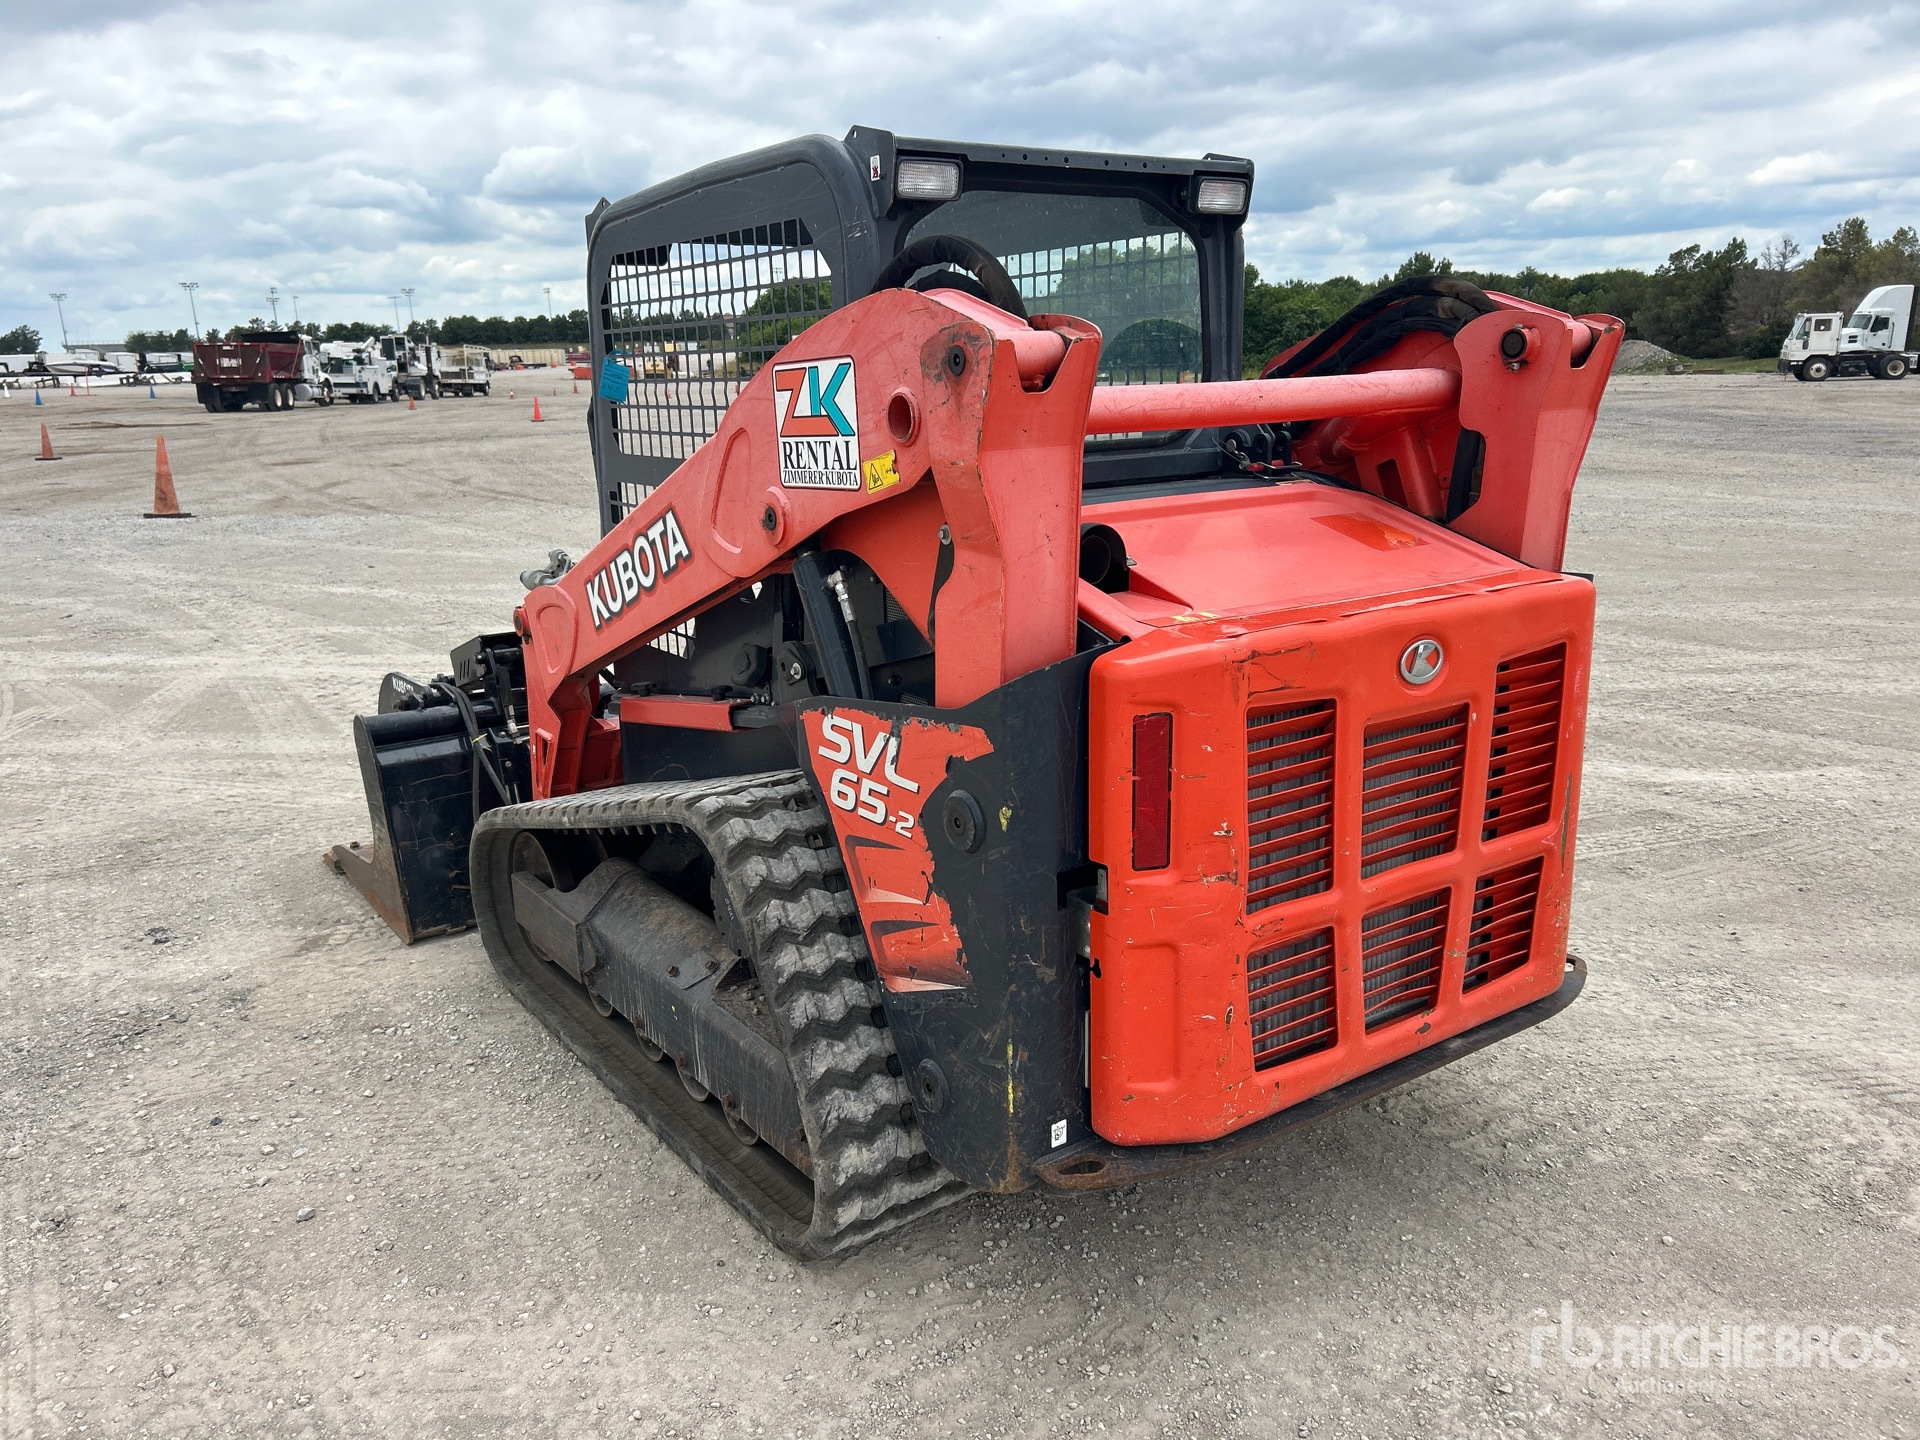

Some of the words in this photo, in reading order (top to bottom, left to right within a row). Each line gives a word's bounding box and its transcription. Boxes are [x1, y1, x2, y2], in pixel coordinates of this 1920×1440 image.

[775, 362, 856, 438] ZK
[782, 440, 858, 471] RENTAL
[783, 470, 825, 485] ZIMMERER
[825, 470, 859, 487] KUBOTA
[585, 510, 690, 629] KUBOTA
[818, 714, 919, 794] SVL
[830, 768, 916, 839] 65-2
